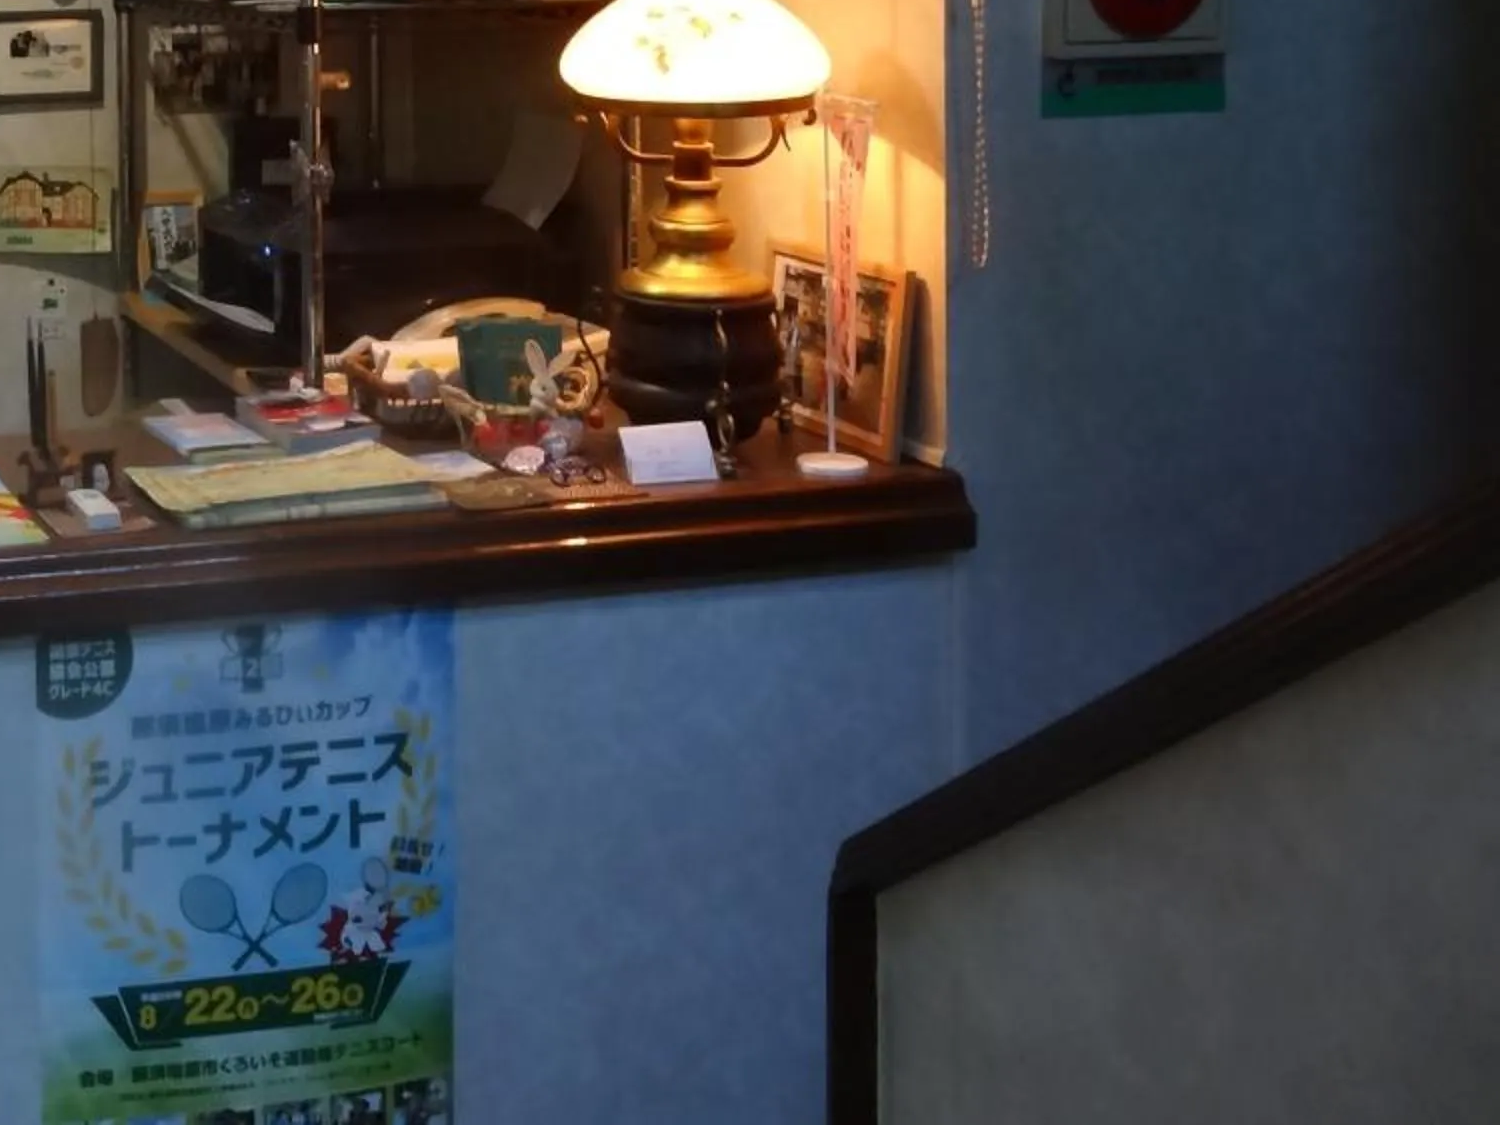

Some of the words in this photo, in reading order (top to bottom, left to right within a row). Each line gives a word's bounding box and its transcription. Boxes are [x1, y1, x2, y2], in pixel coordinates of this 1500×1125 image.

[89, 732, 414, 809] ジュニアテニス
[121, 798, 386, 873] トーナメント
